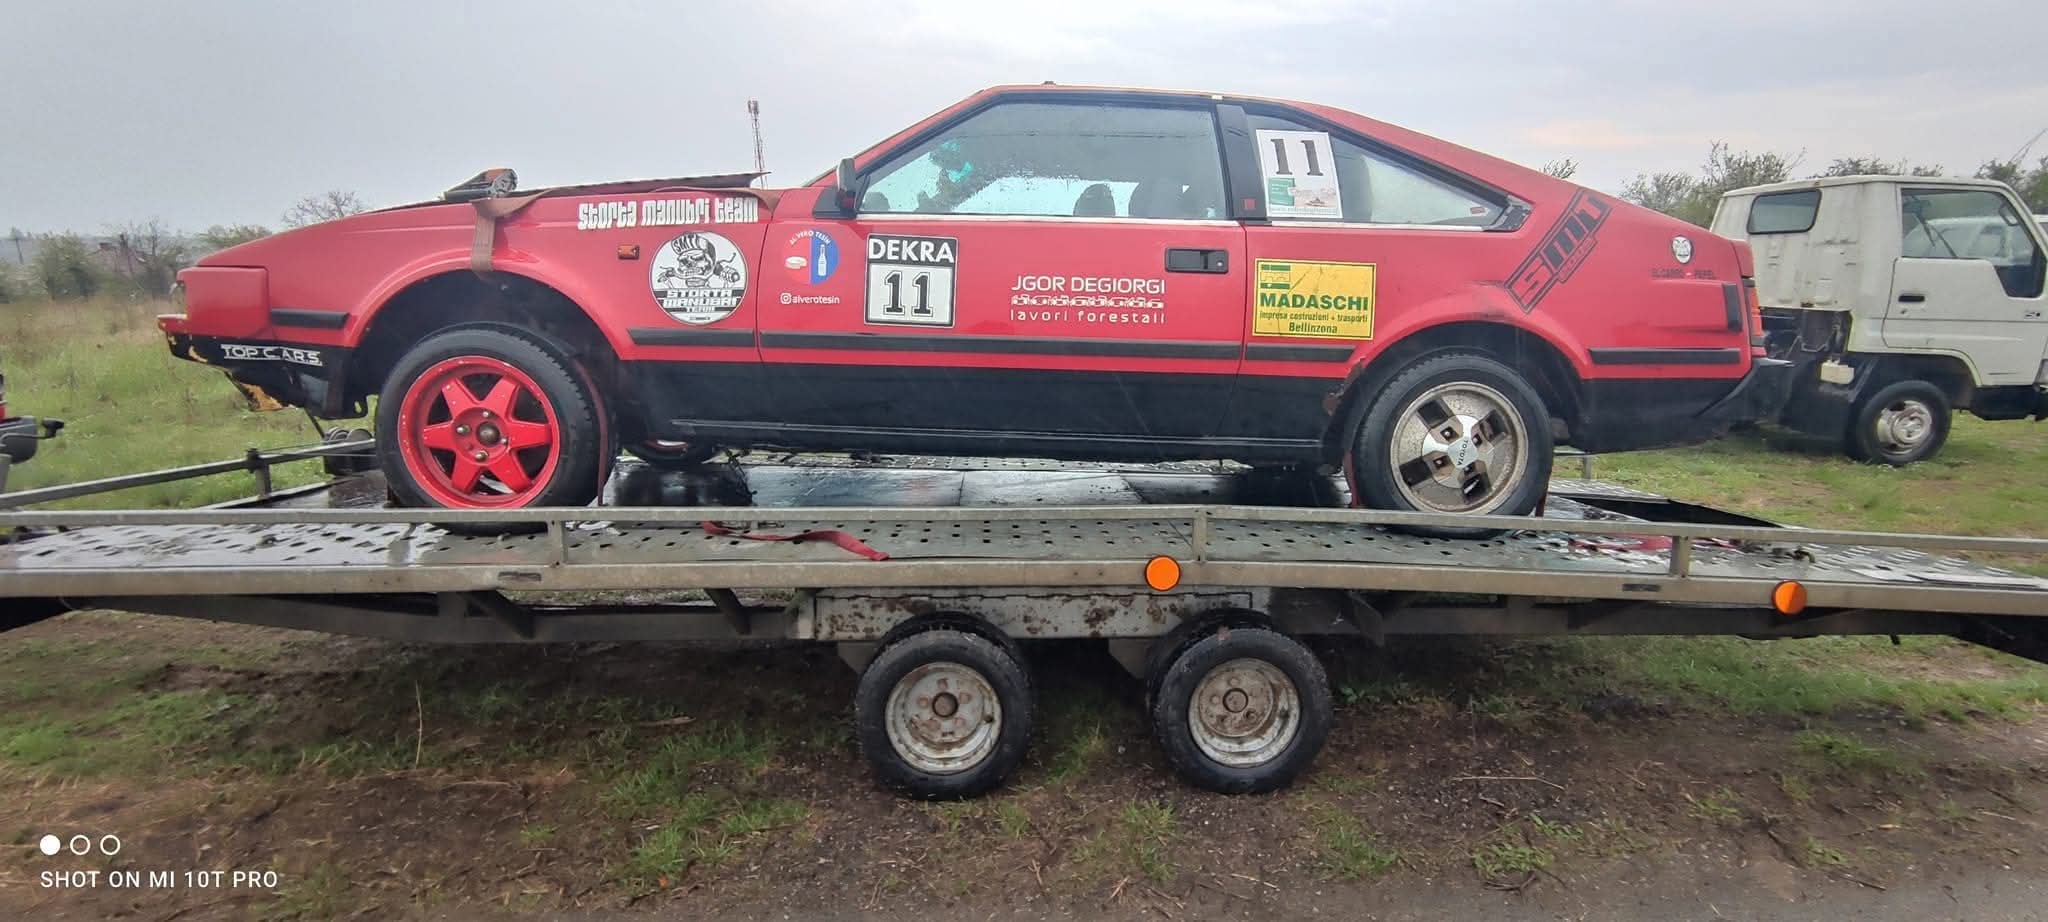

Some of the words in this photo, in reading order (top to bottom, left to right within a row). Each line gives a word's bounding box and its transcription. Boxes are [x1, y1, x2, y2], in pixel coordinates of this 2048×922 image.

[1270, 138, 1324, 177] 11
[868, 238, 955, 263] DEKRA
[666, 289, 733, 298] STORTA
[883, 270, 933, 317] 11
[1011, 275, 1066, 291] JGOR
[1071, 277, 1165, 294] DEGIORGI
[1260, 292, 1369, 311] MADASCHI
[1010, 309, 1069, 321] lavori
[1078, 310, 1165, 324] forestali
[1260, 311, 1288, 321] impresa
[1288, 321, 1339, 334] Bellinzona
[222, 345, 258, 359] TOP
[1457, 440, 1469, 466] TOYOTA
